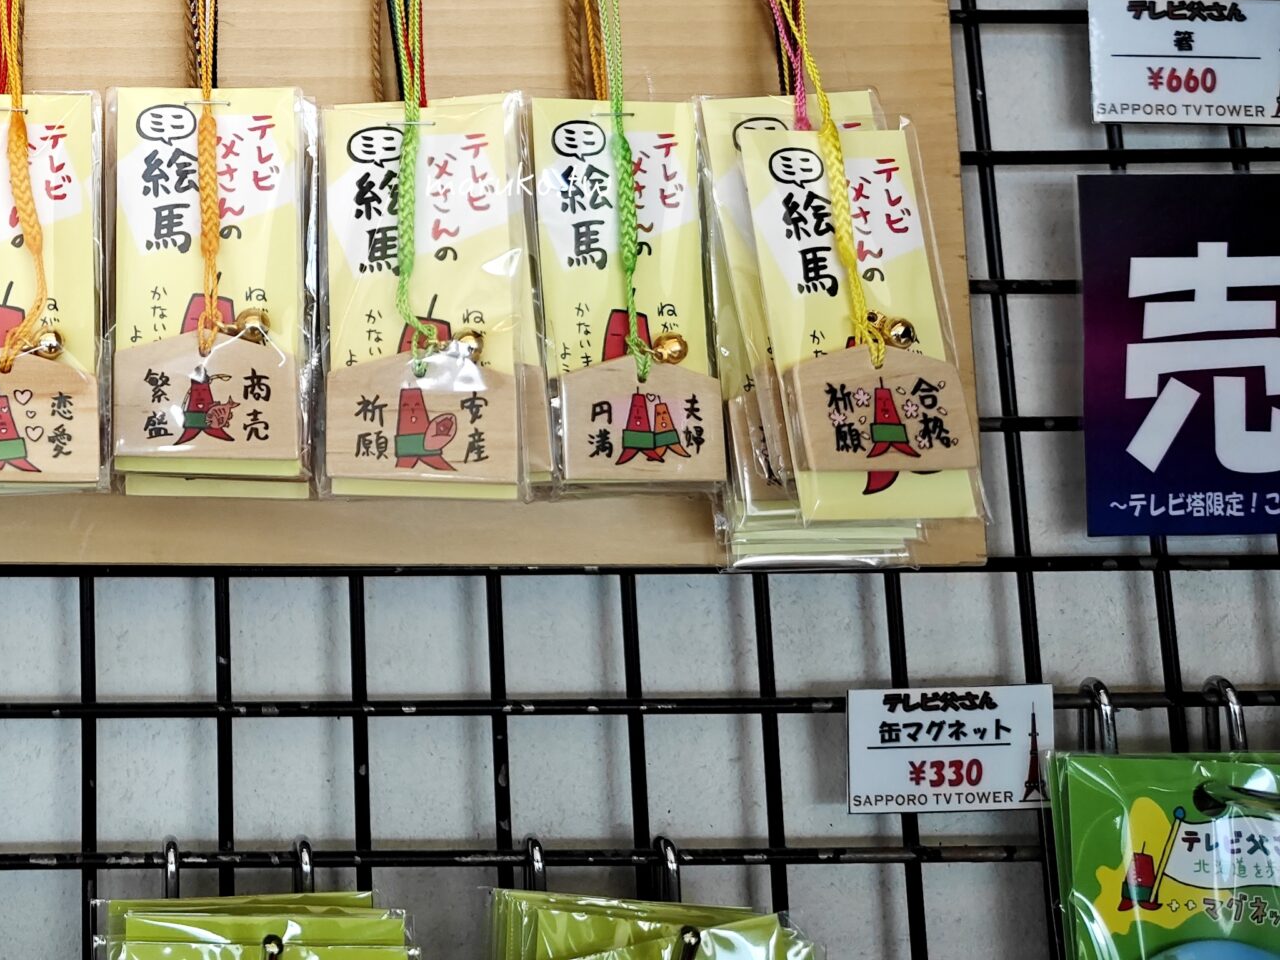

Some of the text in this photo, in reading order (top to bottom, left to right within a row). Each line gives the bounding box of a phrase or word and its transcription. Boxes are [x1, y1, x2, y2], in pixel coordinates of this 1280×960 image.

[1127, 0, 1247, 22] テレビ父さん
[1173, 30, 1195, 51] 箸
[1096, 103, 1178, 116] SAPPORO
[1147, 66, 1217, 93] ¥660
[150, 113, 185, 132] ミニ
[248, 116, 280, 191] テレビ
[361, 135, 396, 155] ミニ
[563, 128, 595, 148] ミニ
[40, 125, 72, 201] テレビ
[216, 133, 245, 239] 父さんの
[461, 133, 495, 211] テレビ
[653, 133, 684, 209] テレビ
[780, 155, 813, 175] ミニ
[874, 158, 911, 234] テレビ
[141, 148, 200, 254] 絵馬
[427, 153, 460, 261] 父さんの
[561, 164, 613, 270] 絵馬
[846, 176, 885, 282] 父さんの
[782, 190, 839, 297] 絵馬
[48, 391, 73, 458] 恋愛
[143, 368, 174, 439] 繁盛
[242, 368, 271, 441] 商売
[354, 394, 389, 460] 祈願
[460, 391, 489, 464] 安産
[588, 401, 613, 458] 円満
[683, 394, 705, 454] 夫婦
[825, 382, 866, 452] 祈願
[910, 378, 951, 449] 合格
[879, 719, 1012, 744] 缶マグネット
[883, 692, 998, 712] テレビ父さん
[853, 794, 928, 807] SAPPORO
[909, 759, 983, 788] ¥330
